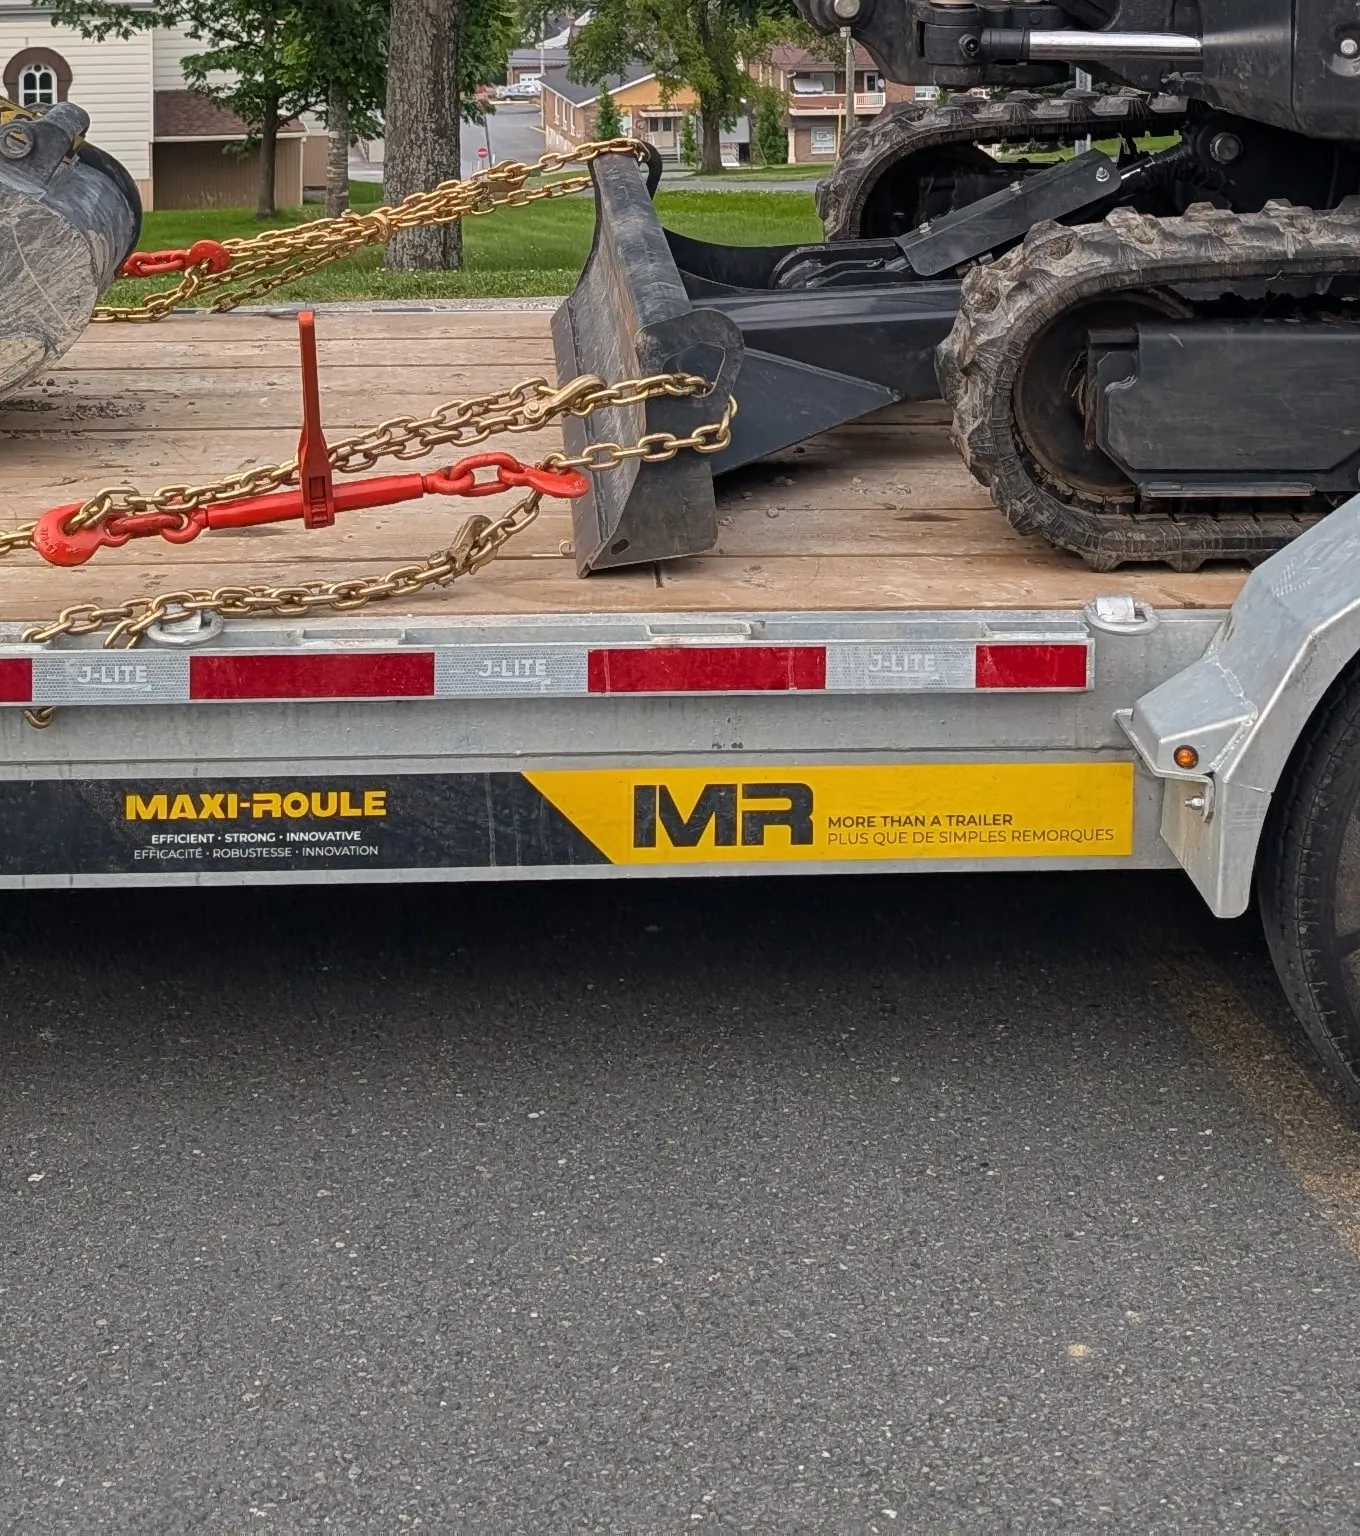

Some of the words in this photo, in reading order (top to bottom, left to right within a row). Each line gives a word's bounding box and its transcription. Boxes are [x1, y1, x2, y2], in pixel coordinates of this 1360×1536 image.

[478, 660, 546, 677] J-LITE
[868, 654, 936, 671] J-LITE
[77, 666, 148, 683] J-LITE
[125, 790, 387, 820] MAXI-ROULE
[633, 782, 814, 848] MR
[828, 814, 877, 829] MORE
[880, 814, 926, 828] THAN
[931, 814, 943, 828] A
[946, 813, 1014, 828] TRAILER
[151, 833, 215, 845] EFFICIENT
[224, 832, 276, 844] STRONG
[286, 830, 362, 843] INNOVATIVE
[828, 830, 869, 846] PLUS
[872, 830, 909, 847] QUE
[913, 830, 936, 844] DE
[938, 828, 1008, 844] SIMPLES
[1011, 828, 1115, 844] REMORQUES
[134, 846, 203, 860] EFFICACITÉ
[212, 847, 292, 859] ROBUSTESSE
[302, 845, 379, 858] INNOVATION
